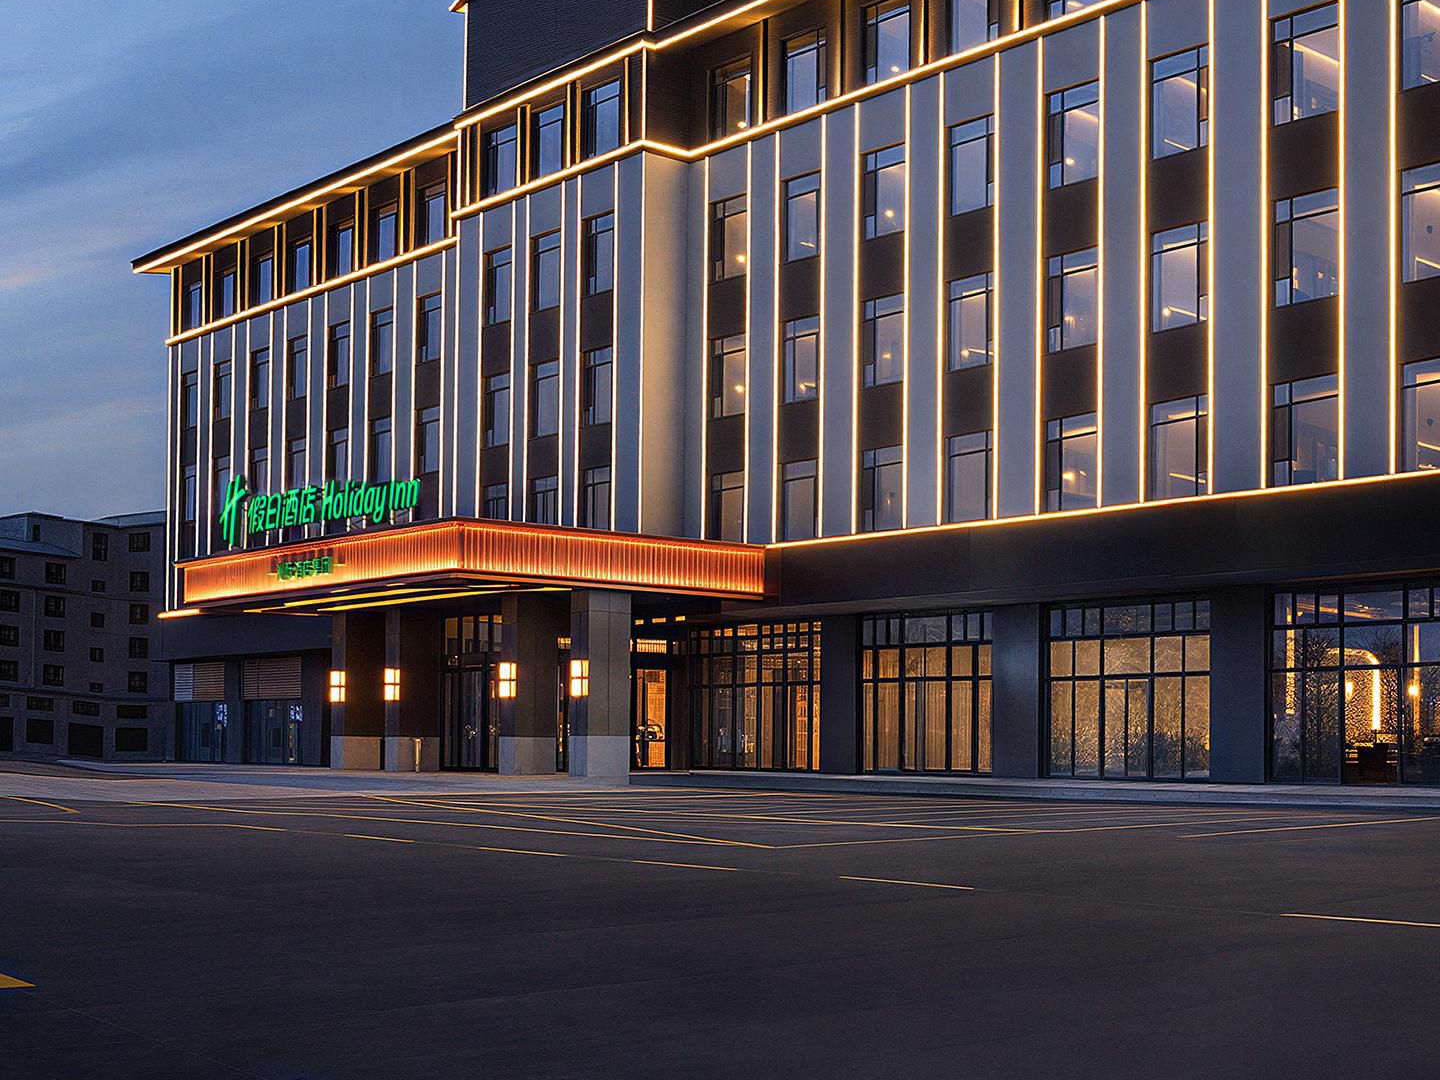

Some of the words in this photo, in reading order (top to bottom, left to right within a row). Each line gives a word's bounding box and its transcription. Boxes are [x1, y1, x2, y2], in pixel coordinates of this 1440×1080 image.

[248, 484, 317, 534] 假日酒店
[320, 478, 388, 524] Holiday
[388, 477, 421, 512] Inn
